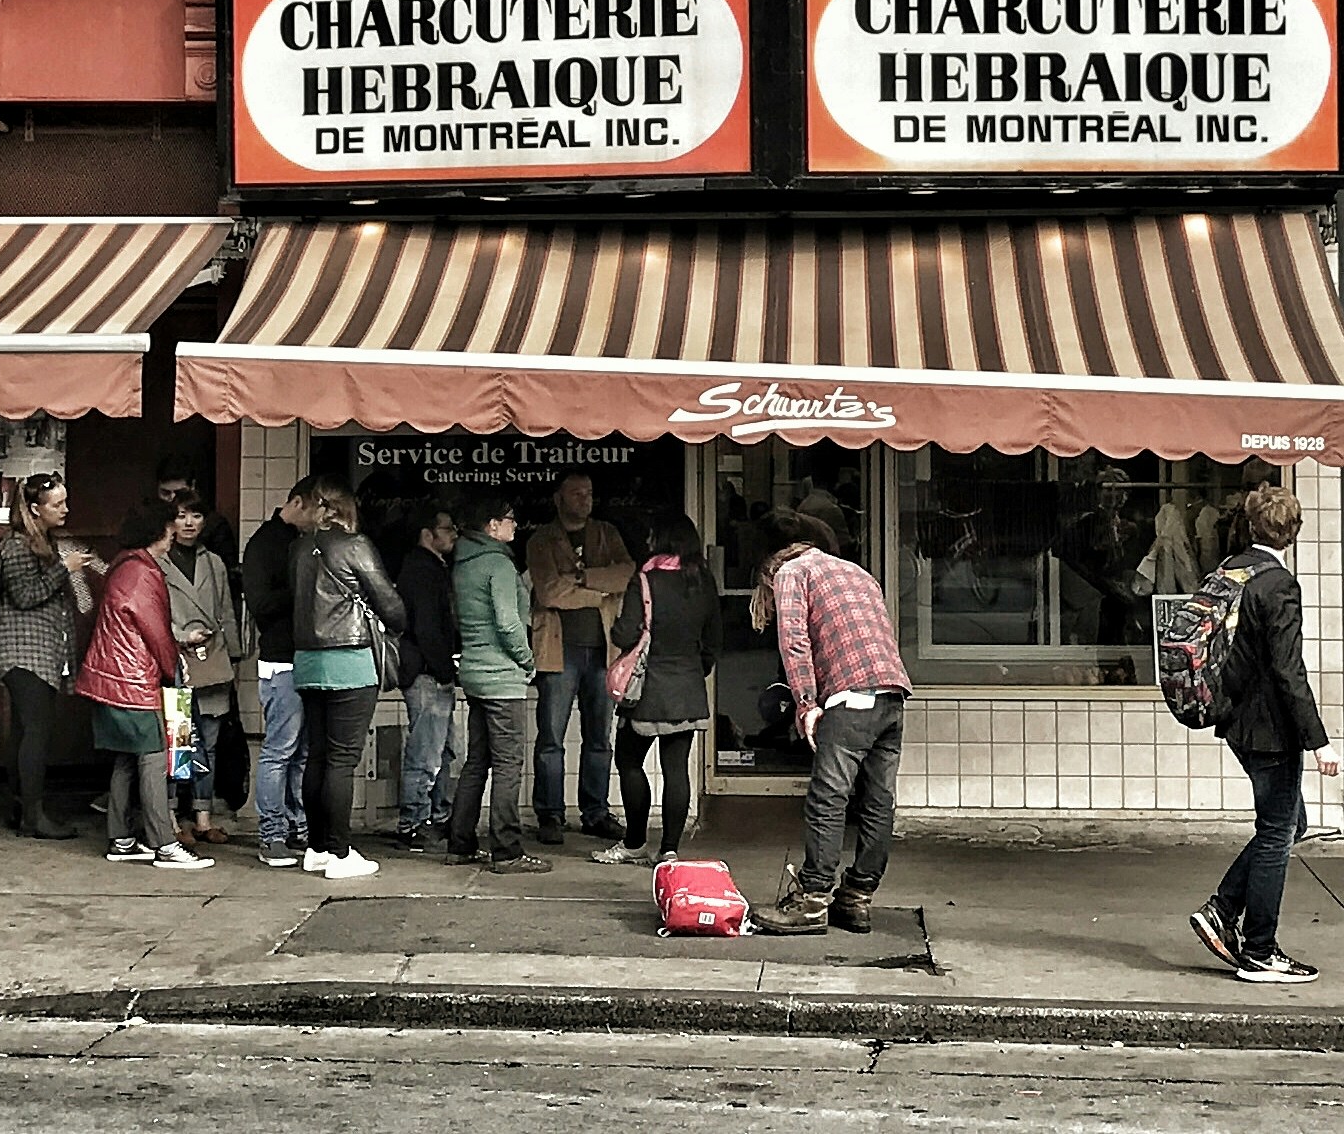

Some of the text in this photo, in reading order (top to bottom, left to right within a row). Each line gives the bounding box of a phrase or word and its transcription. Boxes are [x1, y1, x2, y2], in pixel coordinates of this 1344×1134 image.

[302, 54, 683, 117] HEBRAIQUE
[878, 52, 1271, 111] HEBRAIQUE
[316, 117, 680, 156] DE MONTRÉAL INC.
[893, 111, 1268, 144] DE MONTRÉAL INC.
[667, 382, 897, 437] Schwartz's
[358, 441, 635, 466] Service de Traiteur
[1241, 433, 1325, 451] DEPUIS 1928
[423, 468, 501, 486] Catering
